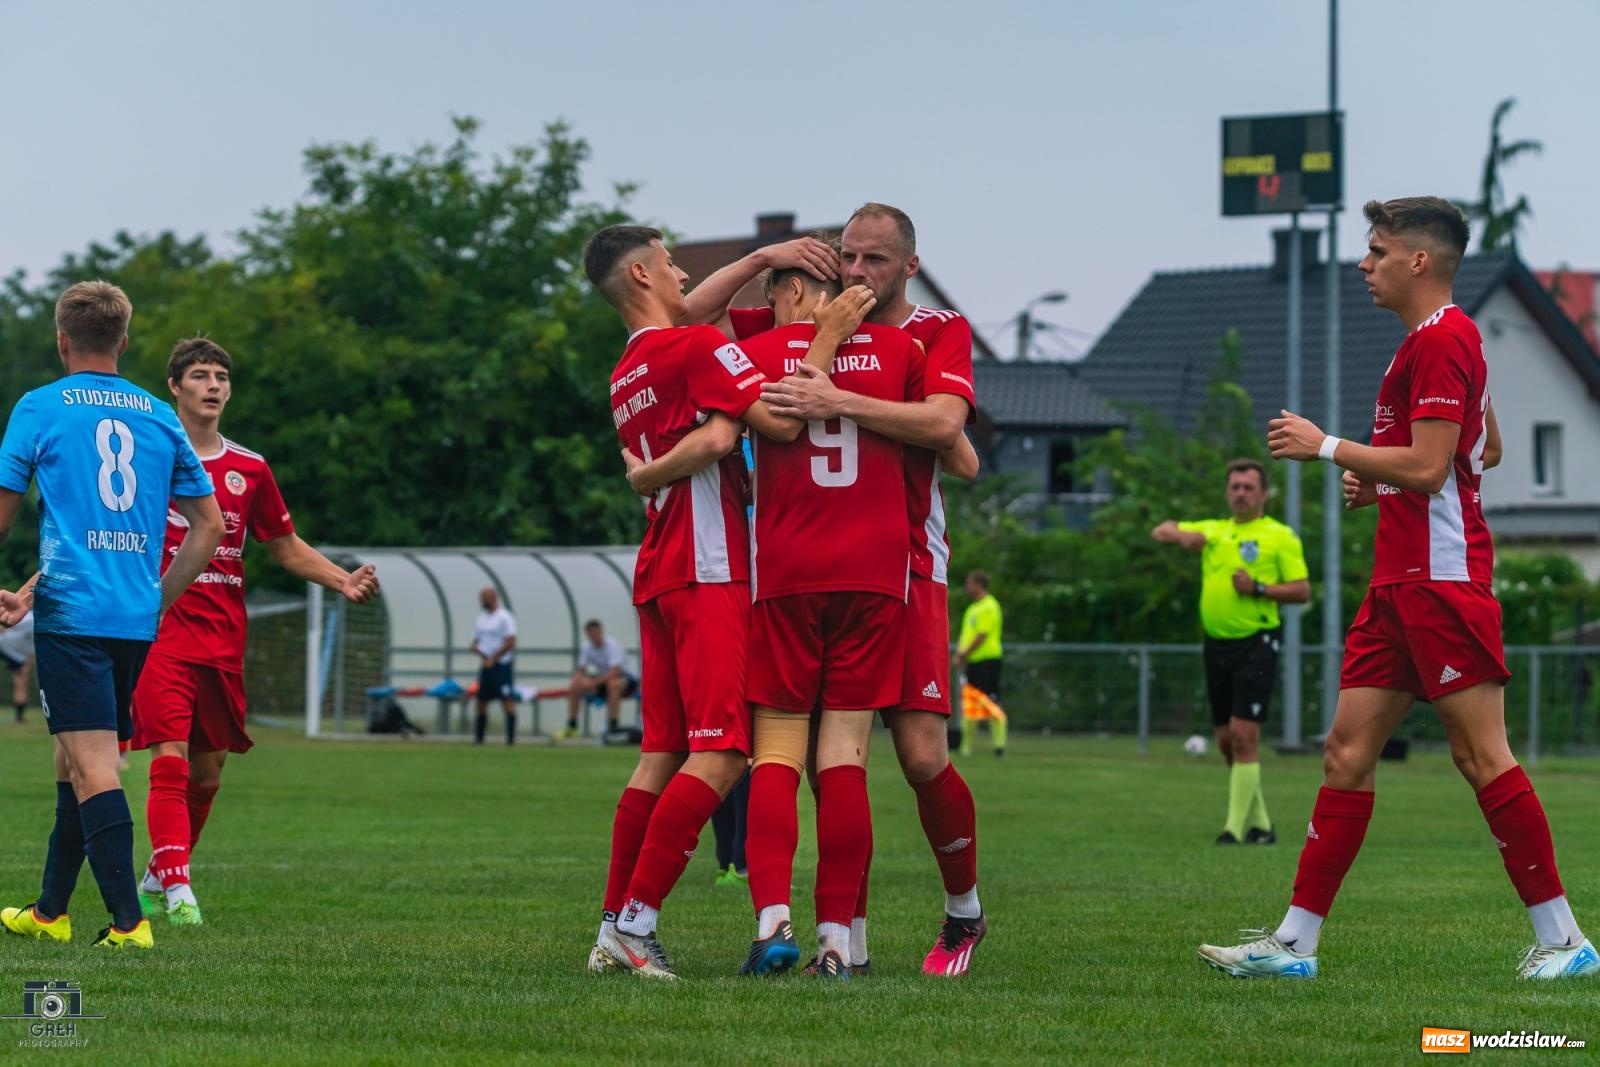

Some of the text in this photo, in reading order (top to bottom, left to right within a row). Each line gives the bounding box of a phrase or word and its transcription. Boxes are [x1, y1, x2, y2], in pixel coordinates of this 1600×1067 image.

[727, 347, 741, 362] 3
[62, 388, 153, 414] STUDZIENNA
[627, 386, 658, 417] TURZA
[807, 414, 859, 488] 9
[95, 418, 138, 513] 8
[87, 528, 148, 553] RACIBÓRZ
[694, 728, 724, 738] PATRICK
